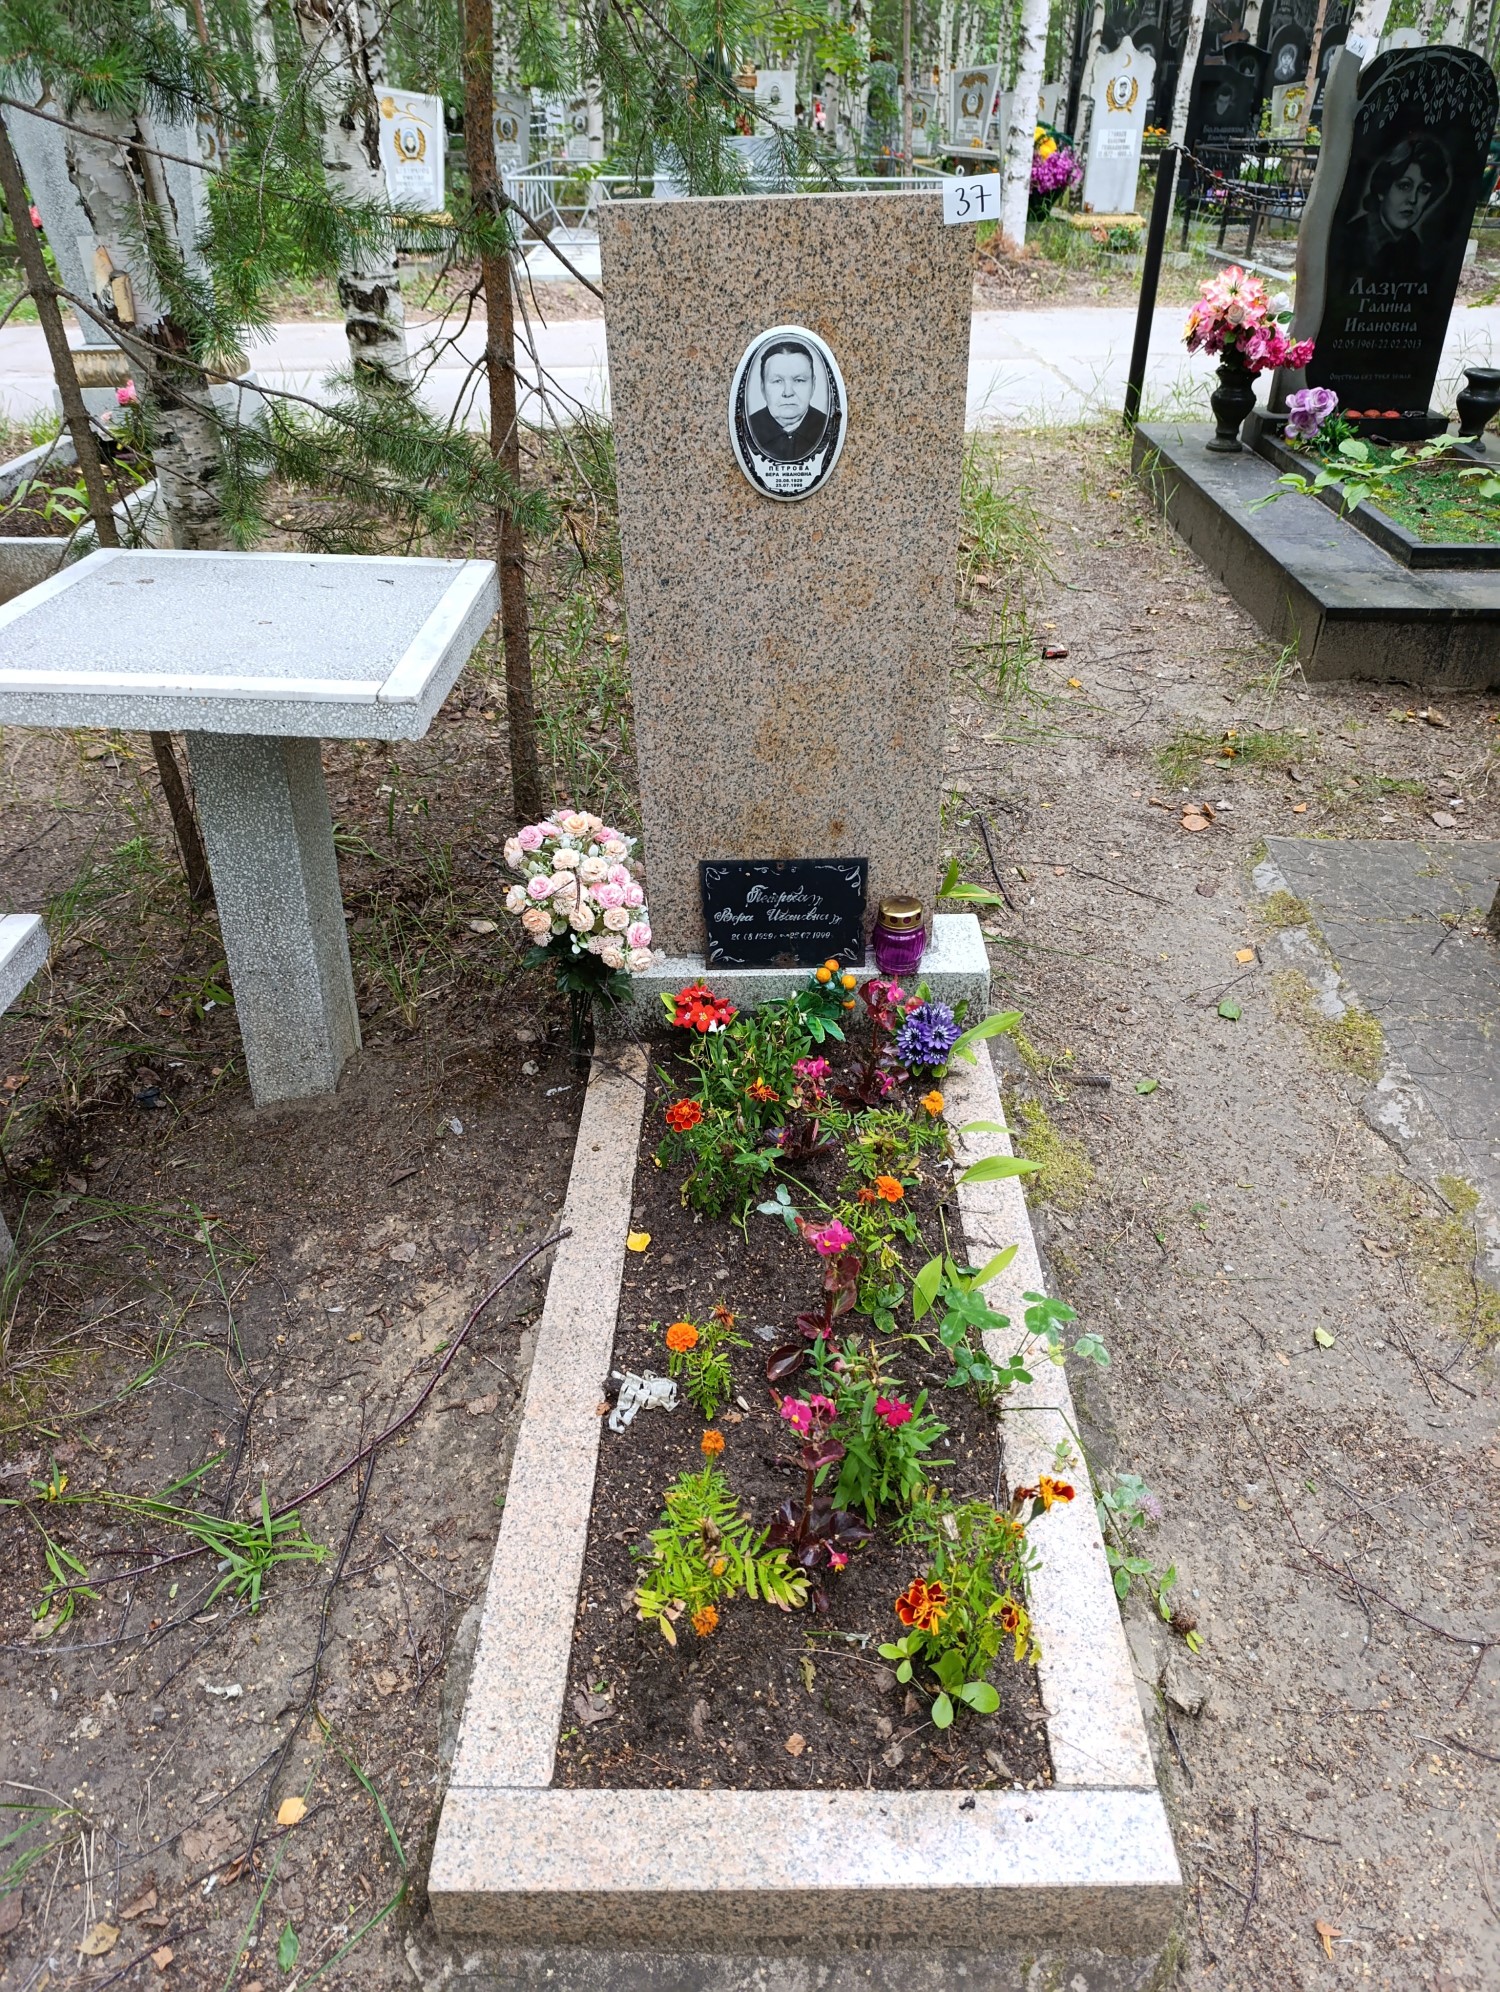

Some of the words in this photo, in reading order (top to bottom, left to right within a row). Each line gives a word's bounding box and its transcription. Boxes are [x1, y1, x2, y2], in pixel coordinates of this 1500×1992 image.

[955, 184, 992, 216] 37
[1349, 277, 1428, 300] Лазута
[1358, 298, 1412, 313] Галина
[1344, 317, 1418, 332] Ивановна
[745, 884, 809, 908] Петрова
[714, 907, 754, 926] Вера
